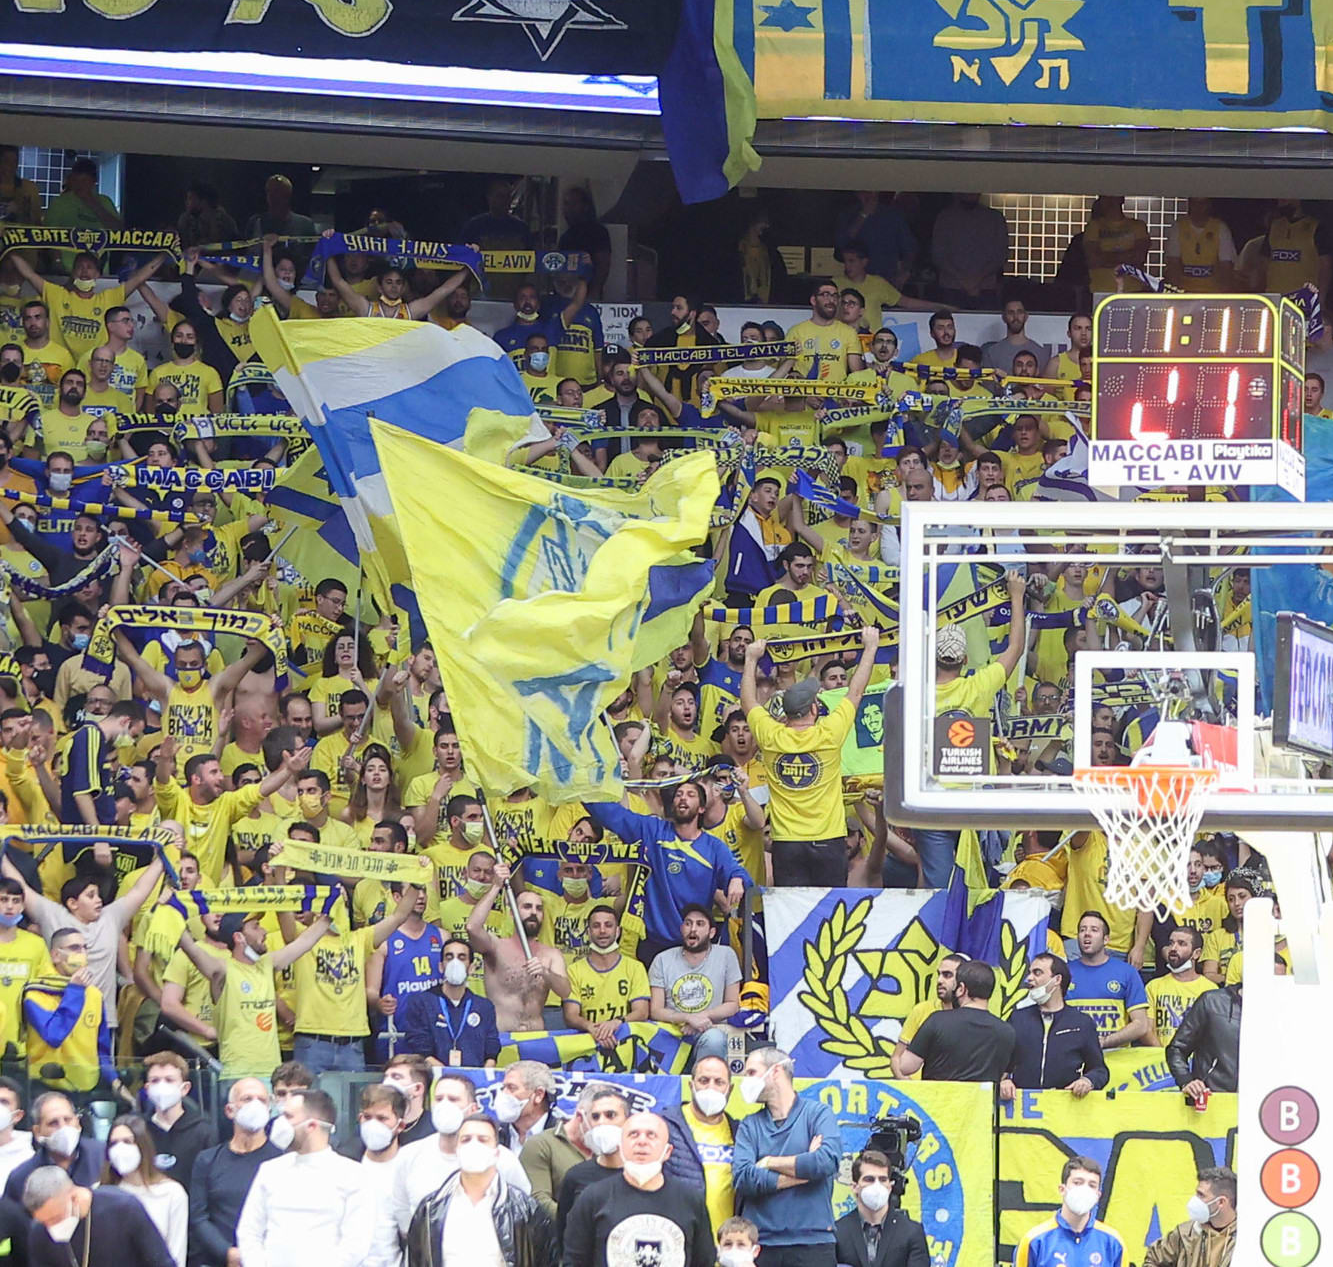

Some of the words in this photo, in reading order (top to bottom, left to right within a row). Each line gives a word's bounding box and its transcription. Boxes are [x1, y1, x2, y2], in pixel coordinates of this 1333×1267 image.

[32, 229, 69, 243] GATE
[482, 253, 534, 270] EL-AVIV
[1271, 251, 1299, 262] FOX
[1184, 266, 1210, 277] FOX
[613, 304, 638, 317] אסור
[655, 349, 713, 363] MACCABI
[719, 348, 746, 359] TEL
[750, 345, 781, 356] AVIV
[721, 384, 825, 397] BASKETBALL
[828, 387, 865, 399] CLUB
[1092, 445, 1203, 461] MACCABI
[1214, 444, 1272, 460] Playtika
[138, 467, 275, 490] MACCABI
[1123, 465, 1165, 481] TEL
[1188, 465, 1242, 481] AVIV
[168, 705, 193, 717] NOW
[194, 704, 212, 716] I'M
[168, 720, 213, 737] BACK
[940, 747, 983, 756] TURKISH
[940, 756, 983, 765] AIRLINES
[939, 765, 983, 775] EuroLeague
[20, 824, 103, 840] MACCABI
[106, 824, 134, 839] TEL
[610, 843, 640, 859] WE
[411, 956, 432, 976] 14
[618, 979, 628, 996] 6
[1279, 1100, 1300, 1131] B
[1281, 1163, 1301, 1194] B
[1281, 1226, 1301, 1256] B
